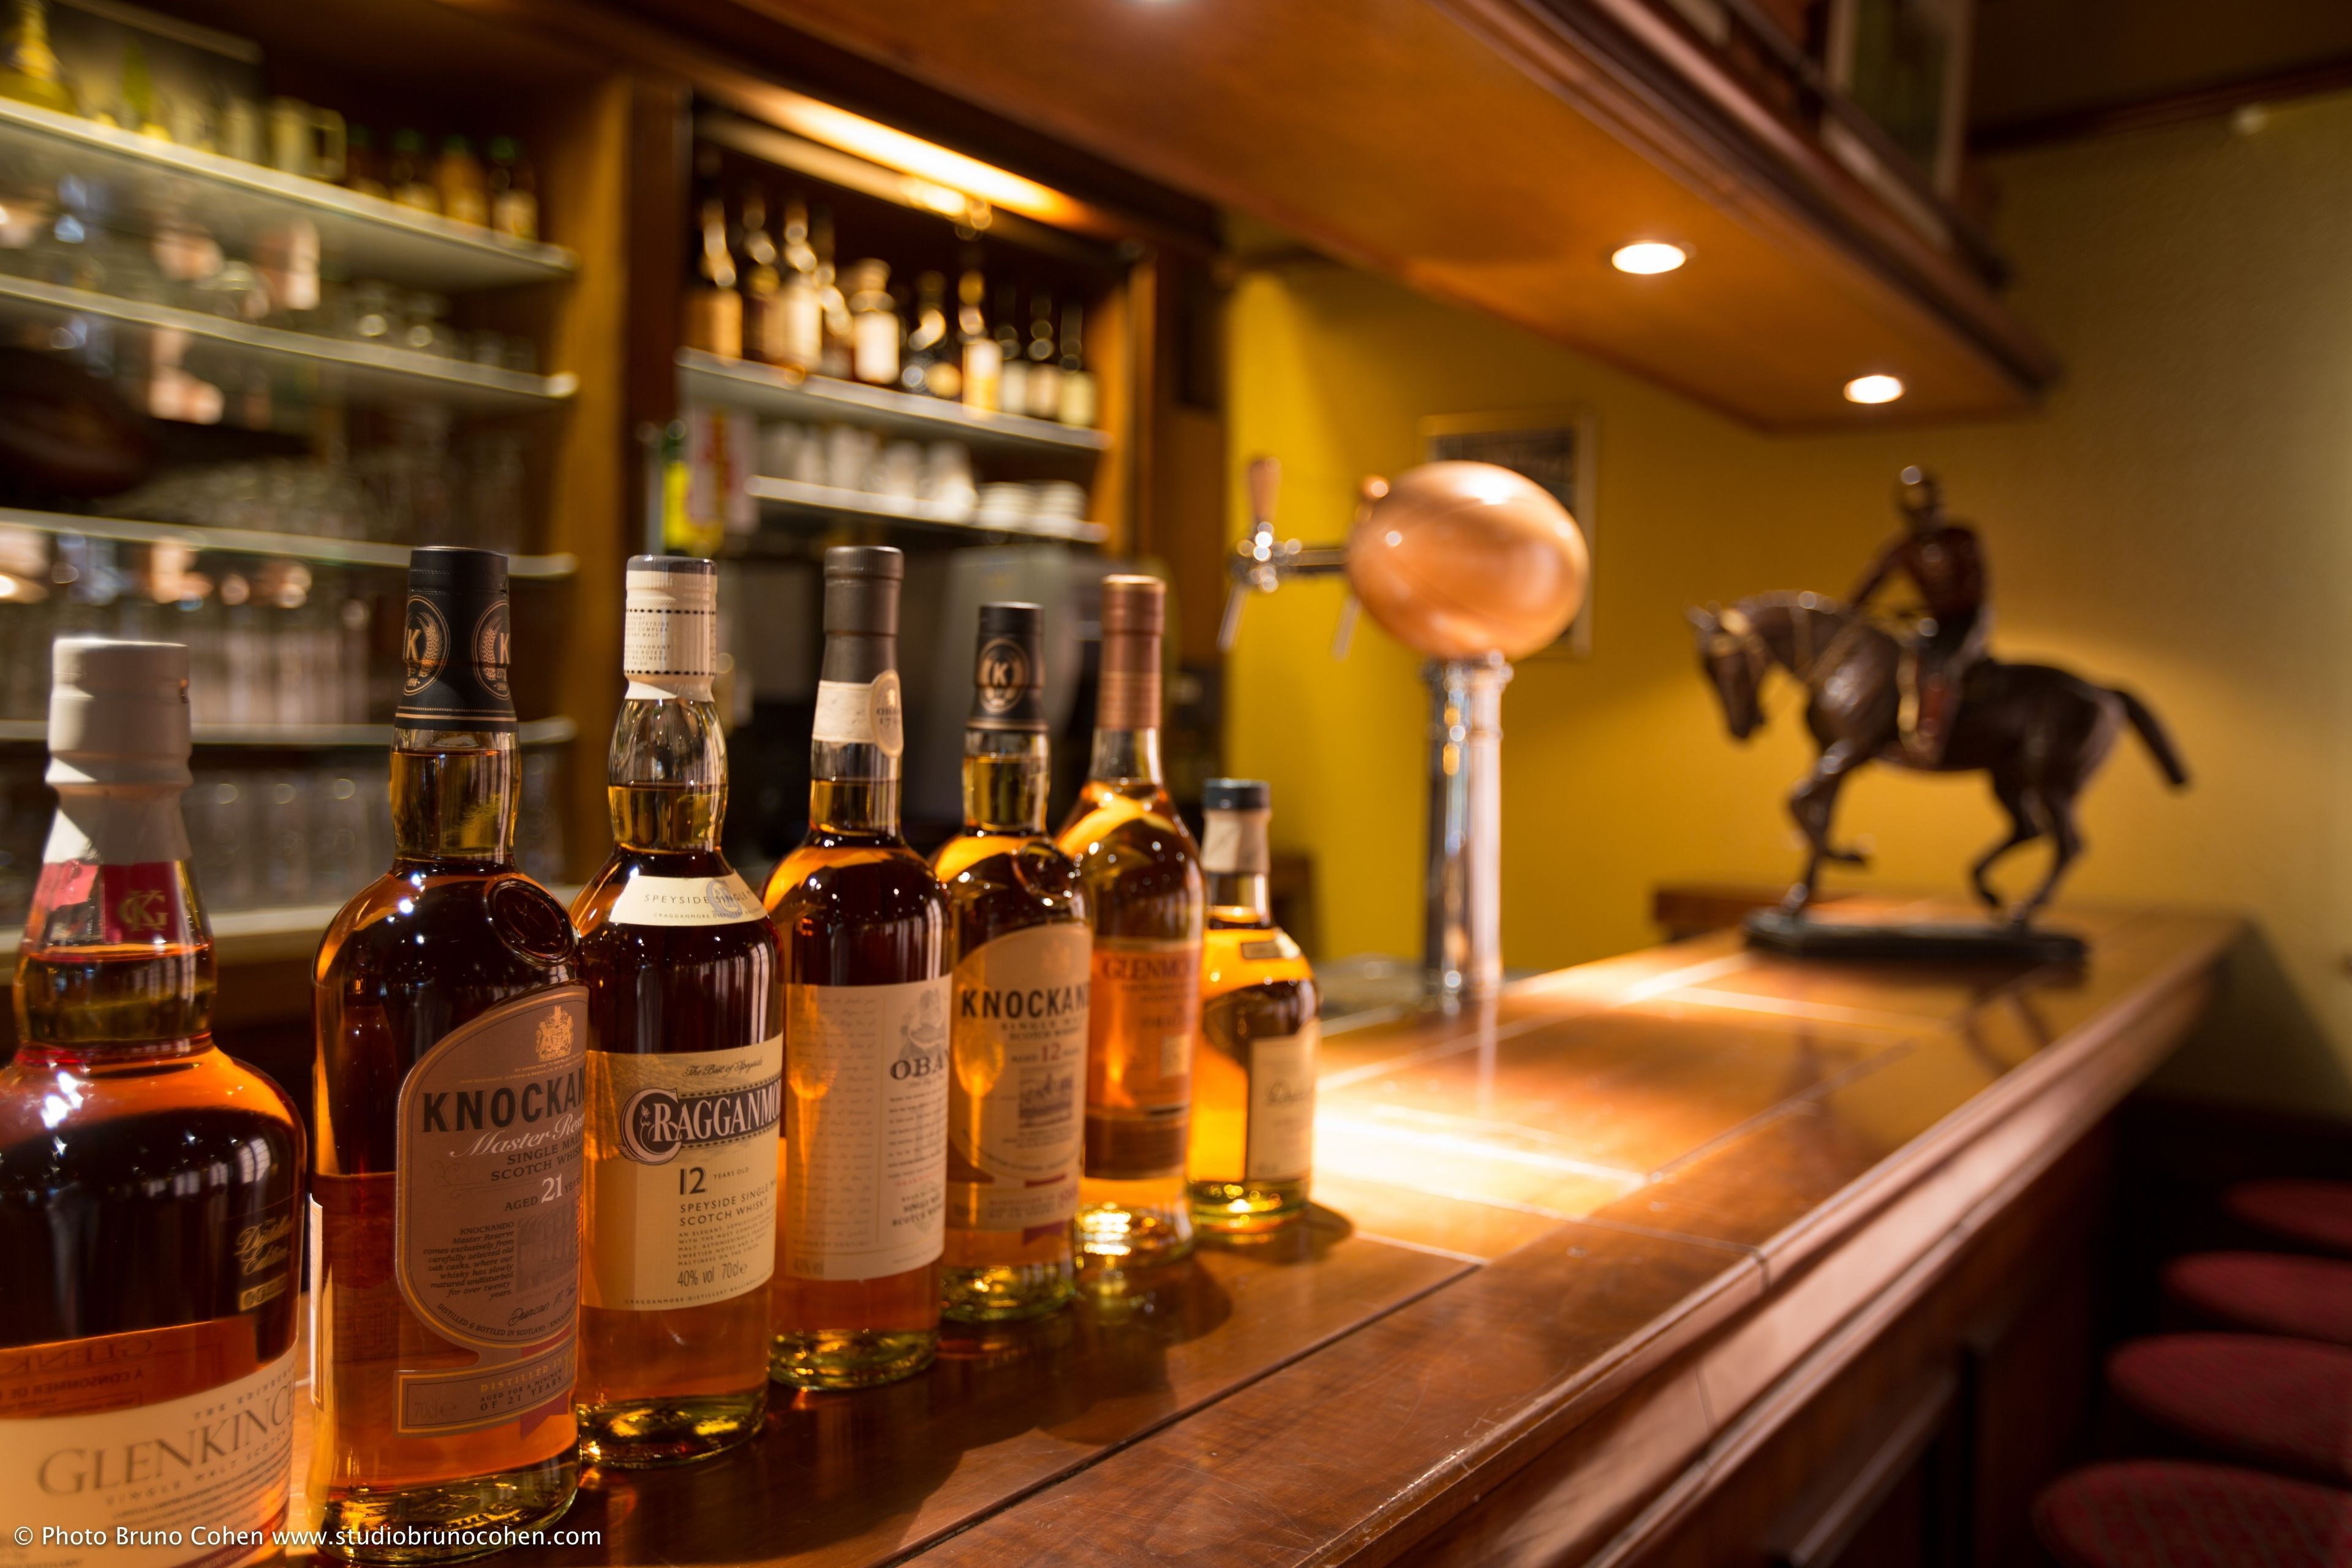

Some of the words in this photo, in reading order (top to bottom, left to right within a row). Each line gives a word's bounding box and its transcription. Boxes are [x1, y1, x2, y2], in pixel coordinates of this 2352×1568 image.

[644, 894, 709, 904] SPEYSIDE
[682, 1065, 702, 1077] The
[449, 1129, 551, 1158] Master
[507, 1144, 559, 1165] SINGLE
[491, 1159, 552, 1181] SCOTCH
[680, 1167, 707, 1195] 12
[714, 1171, 734, 1180] YEARS
[505, 1196, 538, 1212] AGED
[541, 1173, 563, 1204] 21
[680, 1196, 737, 1213] SPEYSIDE
[680, 1210, 732, 1226] SCOTCH
[460, 1221, 514, 1235] KNOCKANDO
[451, 1242, 494, 1253] exclusively
[494, 1238, 514, 1250] from
[452, 1236, 481, 1245] Master
[484, 1231, 514, 1241] Reserve
[429, 1254, 466, 1264] carefully
[468, 1249, 500, 1259] selected
[474, 1259, 498, 1267] where
[431, 1279, 466, 1288] matured
[467, 1271, 514, 1286] undisturbed
[440, 1270, 470, 1280] whisky
[489, 1264, 513, 1274] slowly
[677, 1269, 698, 1287] 40%
[703, 1266, 715, 1284] vol
[446, 1289, 461, 1298] for
[463, 1286, 481, 1295] over
[483, 1281, 511, 1292] twenty
[437, 1303, 468, 1326] DISTILLED
[476, 1325, 506, 1336] BOTTLED
[516, 1325, 545, 1336] SCOTLAND
[480, 1365, 548, 1393] DISTILLED
[480, 1400, 498, 1411] OF
[508, 1395, 522, 1404] 21
[531, 1376, 562, 1396] YEARS
[480, 1392, 504, 1402] AGED
[508, 1387, 524, 1396] FOR
